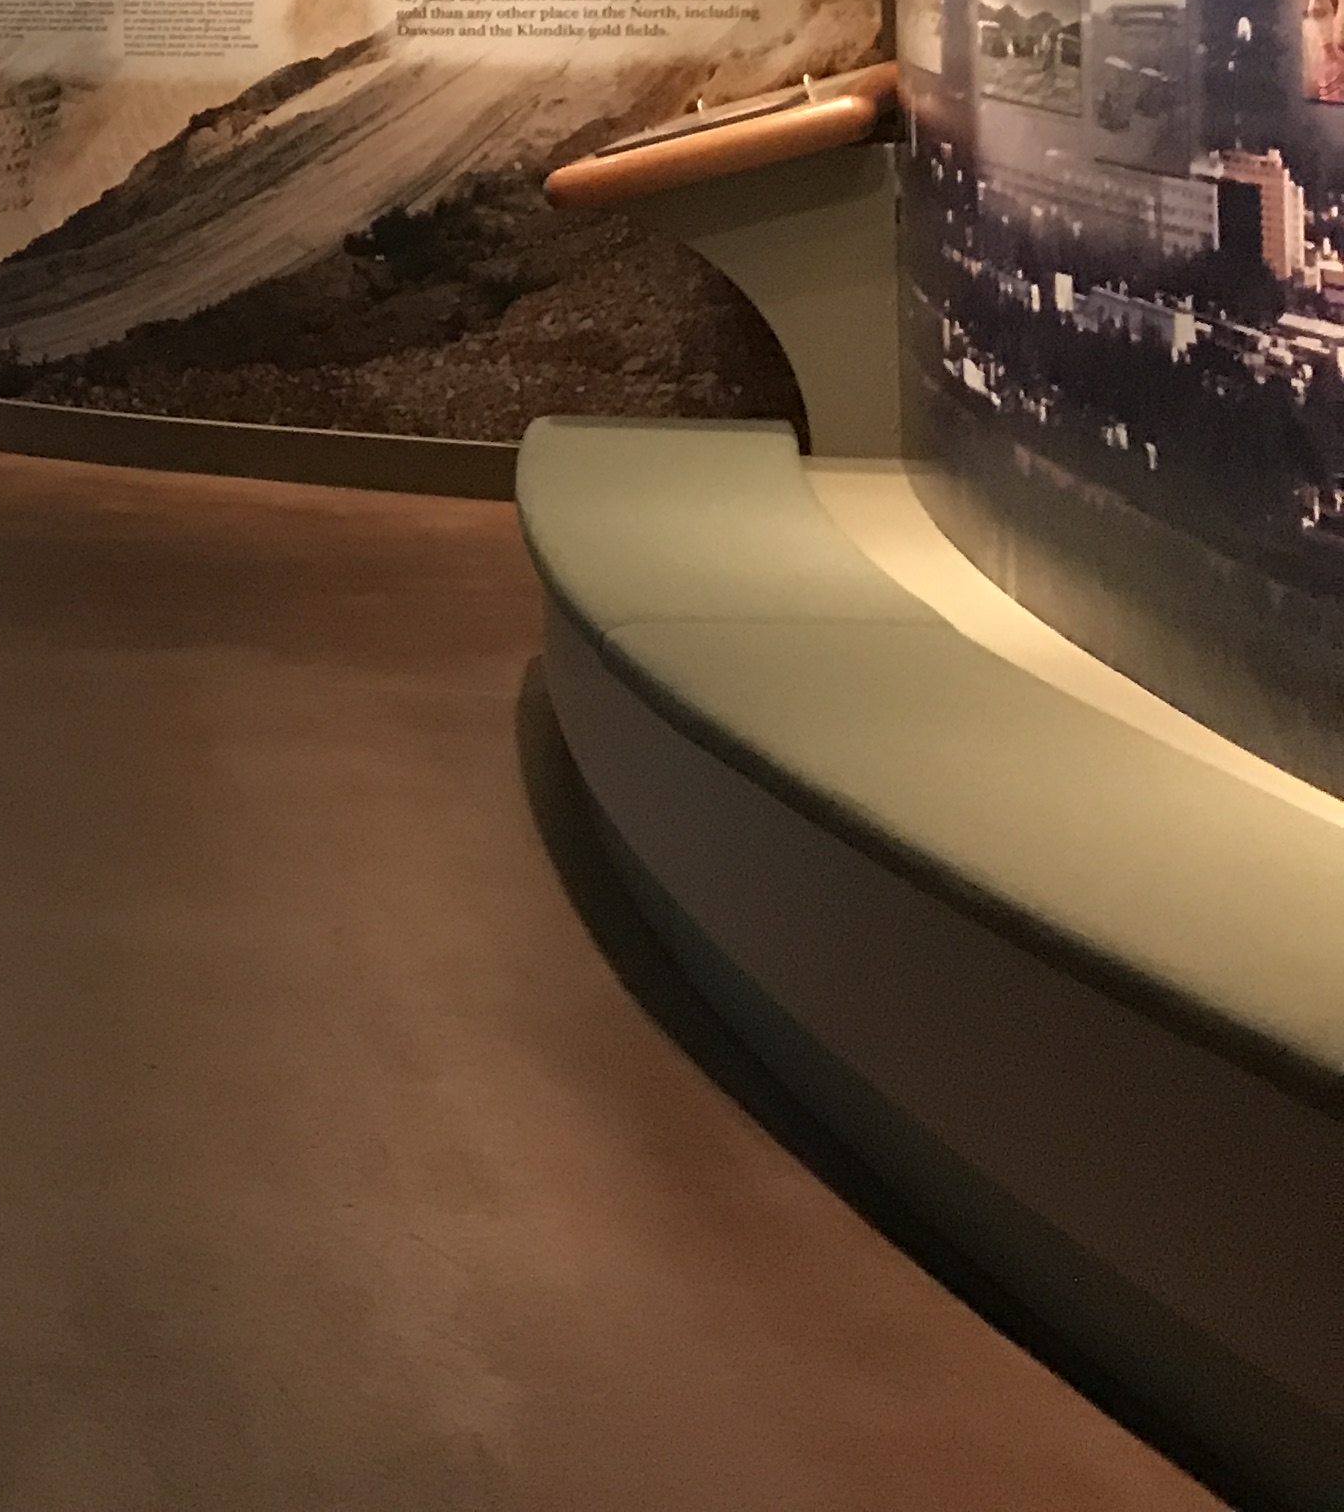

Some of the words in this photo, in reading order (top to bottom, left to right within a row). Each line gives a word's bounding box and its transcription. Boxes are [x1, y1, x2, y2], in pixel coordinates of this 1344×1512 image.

[396, 6, 427, 22] gold
[431, 7, 463, 19] than
[467, 9, 492, 22] any
[496, 6, 537, 19] other
[540, 6, 579, 22] place
[583, 6, 599, 19] in
[602, 6, 625, 19] the
[630, 6, 680, 20] North,
[685, 5, 760, 22] including
[397, 24, 455, 37] Dawson
[458, 24, 486, 36] and
[489, 24, 513, 36] the
[517, 24, 586, 37] Klondike
[588, 24, 621, 38] gold
[625, 23, 669, 37] fields.
